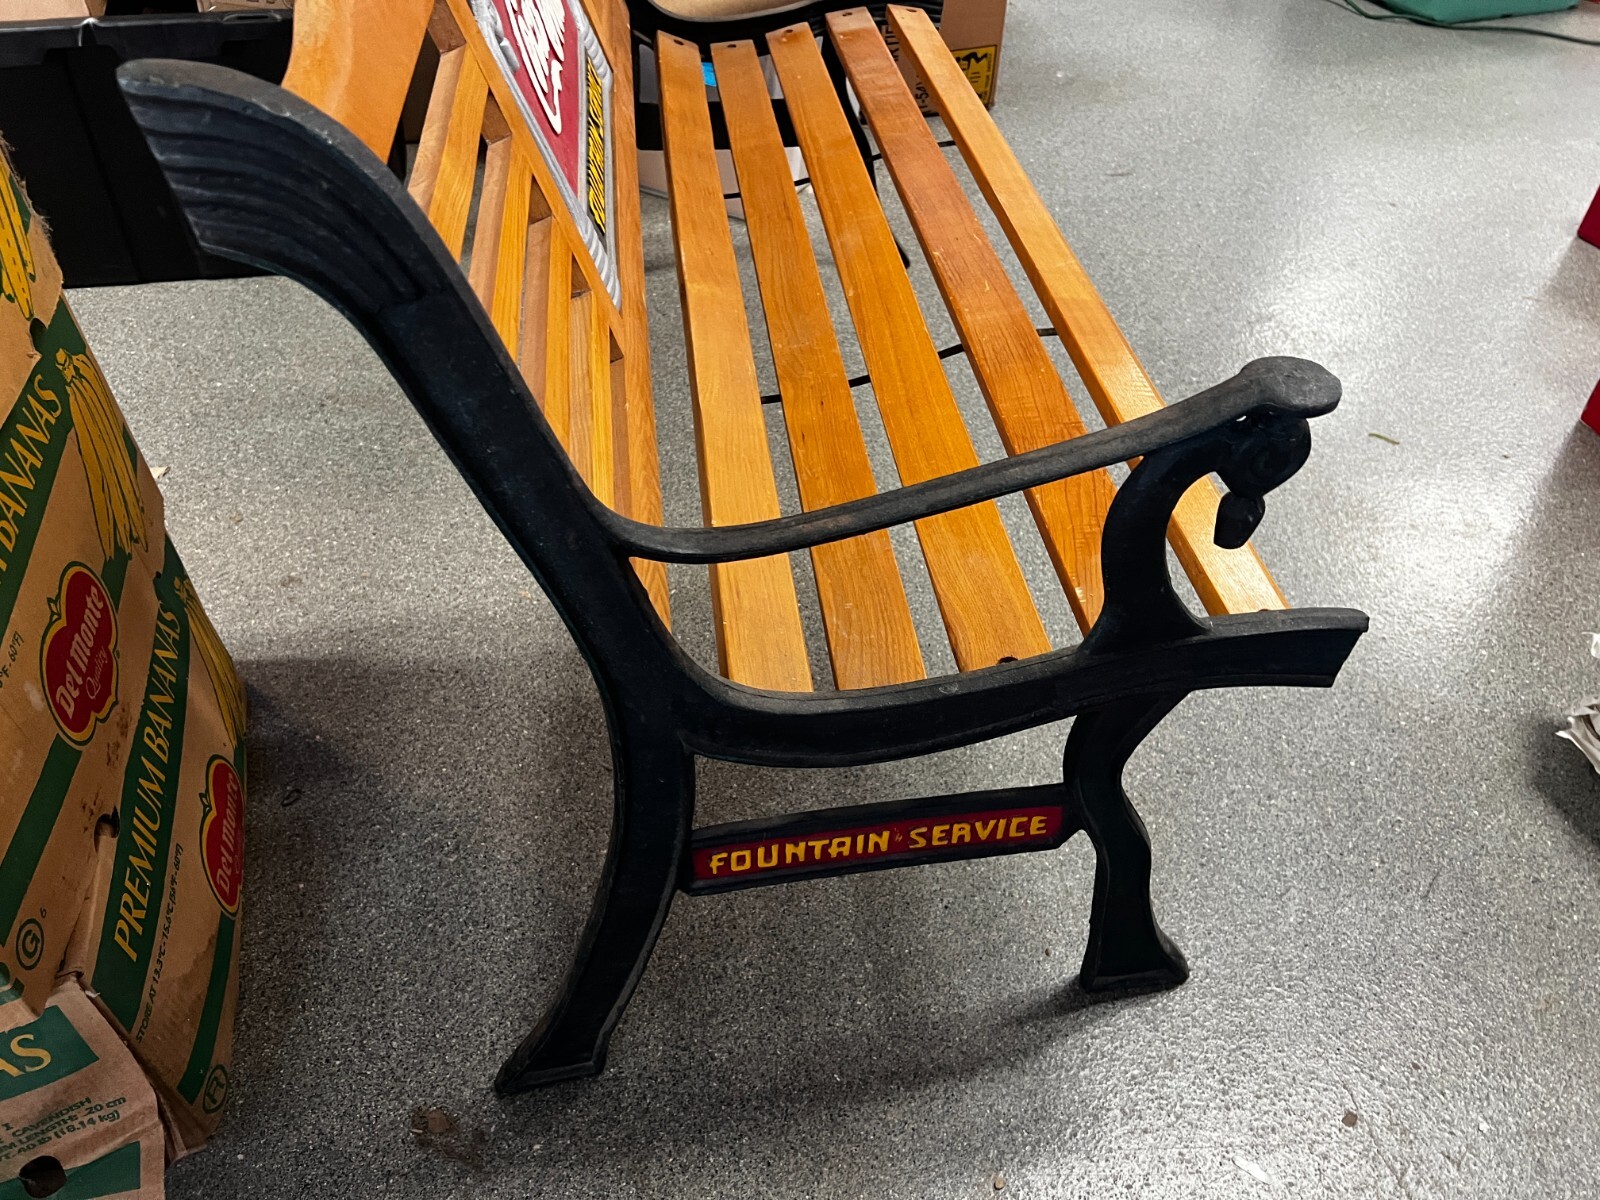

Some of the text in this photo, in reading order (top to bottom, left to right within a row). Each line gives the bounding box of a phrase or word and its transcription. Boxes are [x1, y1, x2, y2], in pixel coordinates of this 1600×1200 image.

[56, 585, 104, 720] Del Monte
[114, 602, 182, 962] PREMIUM BANANAS
[222, 772, 239, 852] Monte
[216, 845, 233, 896] Del
[709, 815, 1048, 875] FOUNTAIN SERVICE
[136, 1002, 153, 1043] STORE
[148, 984, 157, 1004] AT
[12, 1096, 92, 1138] CAVENDISH
[19, 1114, 79, 1145] LENGTH:
[83, 1104, 104, 1116] 20
[105, 1097, 127, 1109] cm
[98, 1109, 120, 1123] kg)
